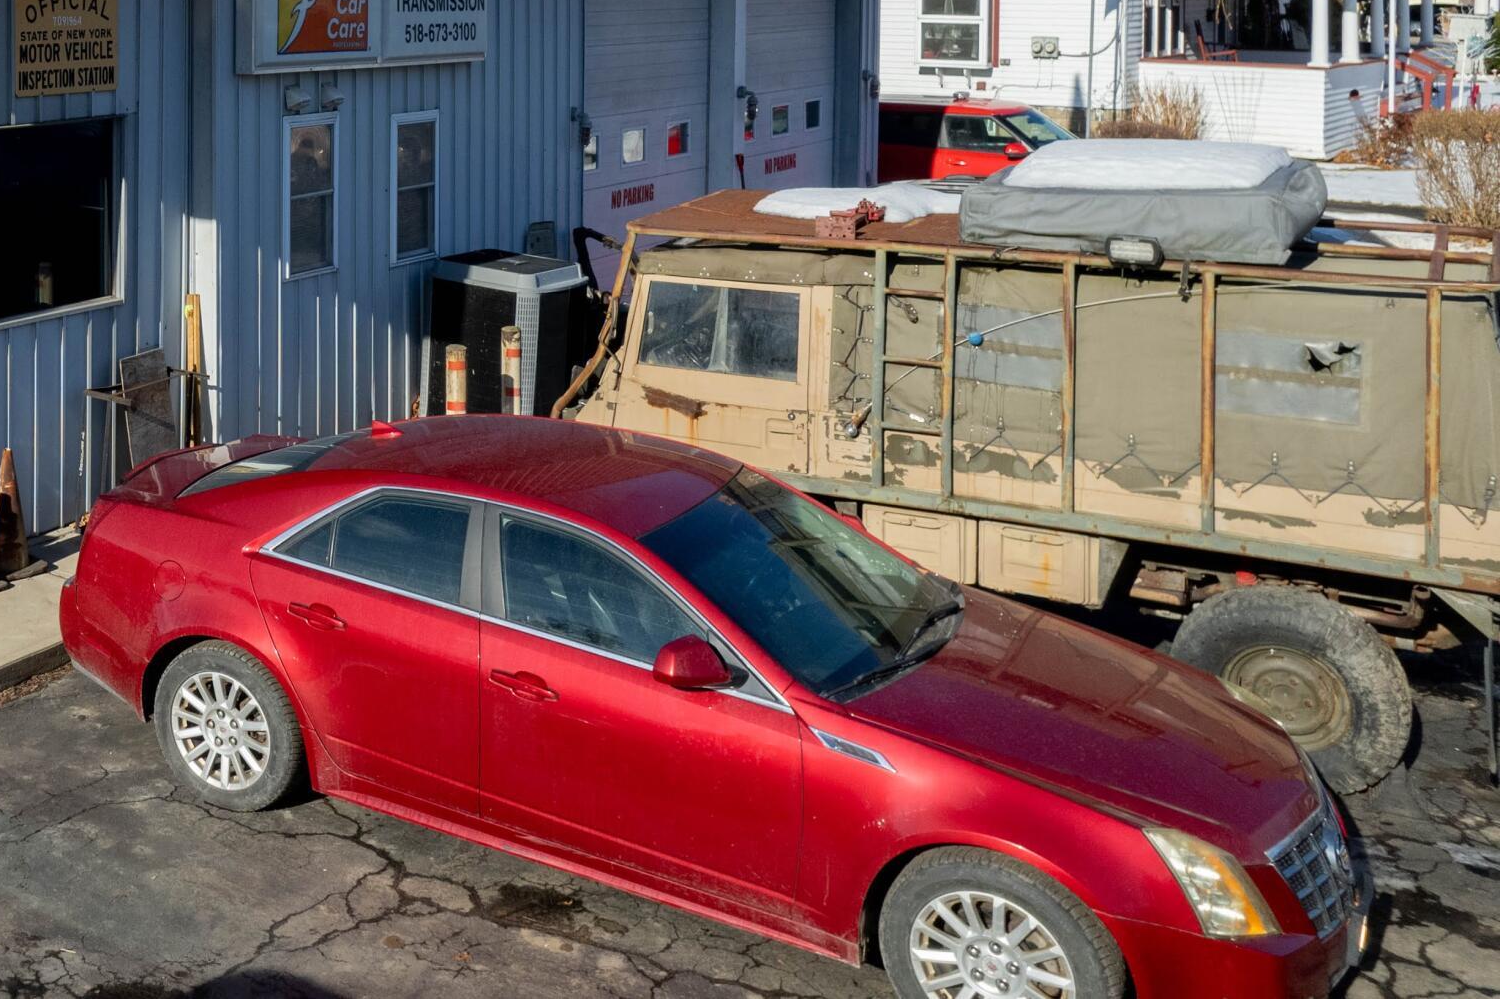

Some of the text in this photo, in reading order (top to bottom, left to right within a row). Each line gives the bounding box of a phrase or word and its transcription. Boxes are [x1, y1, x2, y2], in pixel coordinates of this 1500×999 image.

[20, 28, 112, 42] STATE OF NEW YORK
[327, 18, 366, 39] Care
[404, 22, 476, 44] 518-673-3100
[19, 41, 113, 64] MOTOR VEHICLE
[18, 66, 115, 91] INSPECTION STATION
[764, 153, 797, 175] NO PARKING
[611, 183, 654, 209] NO PARKING
